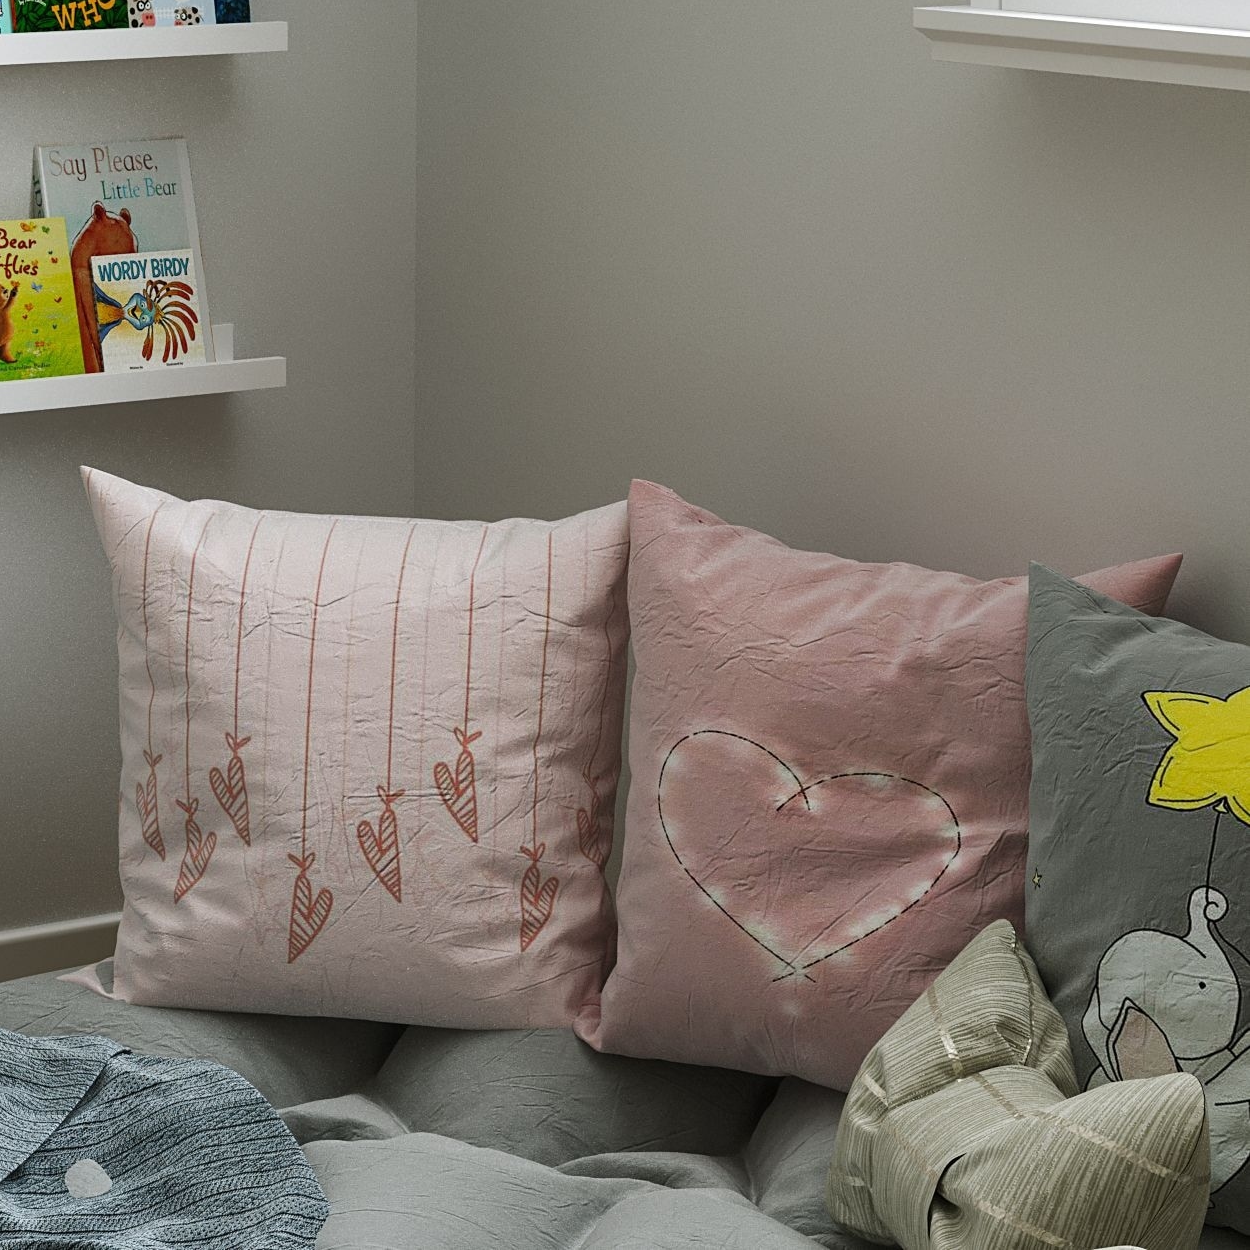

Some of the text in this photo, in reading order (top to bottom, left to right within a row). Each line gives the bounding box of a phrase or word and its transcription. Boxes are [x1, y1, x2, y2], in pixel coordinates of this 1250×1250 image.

[50, 147, 158, 182] Say Please,
[101, 177, 177, 201] Little Bear
[98, 259, 147, 282] WORDY
